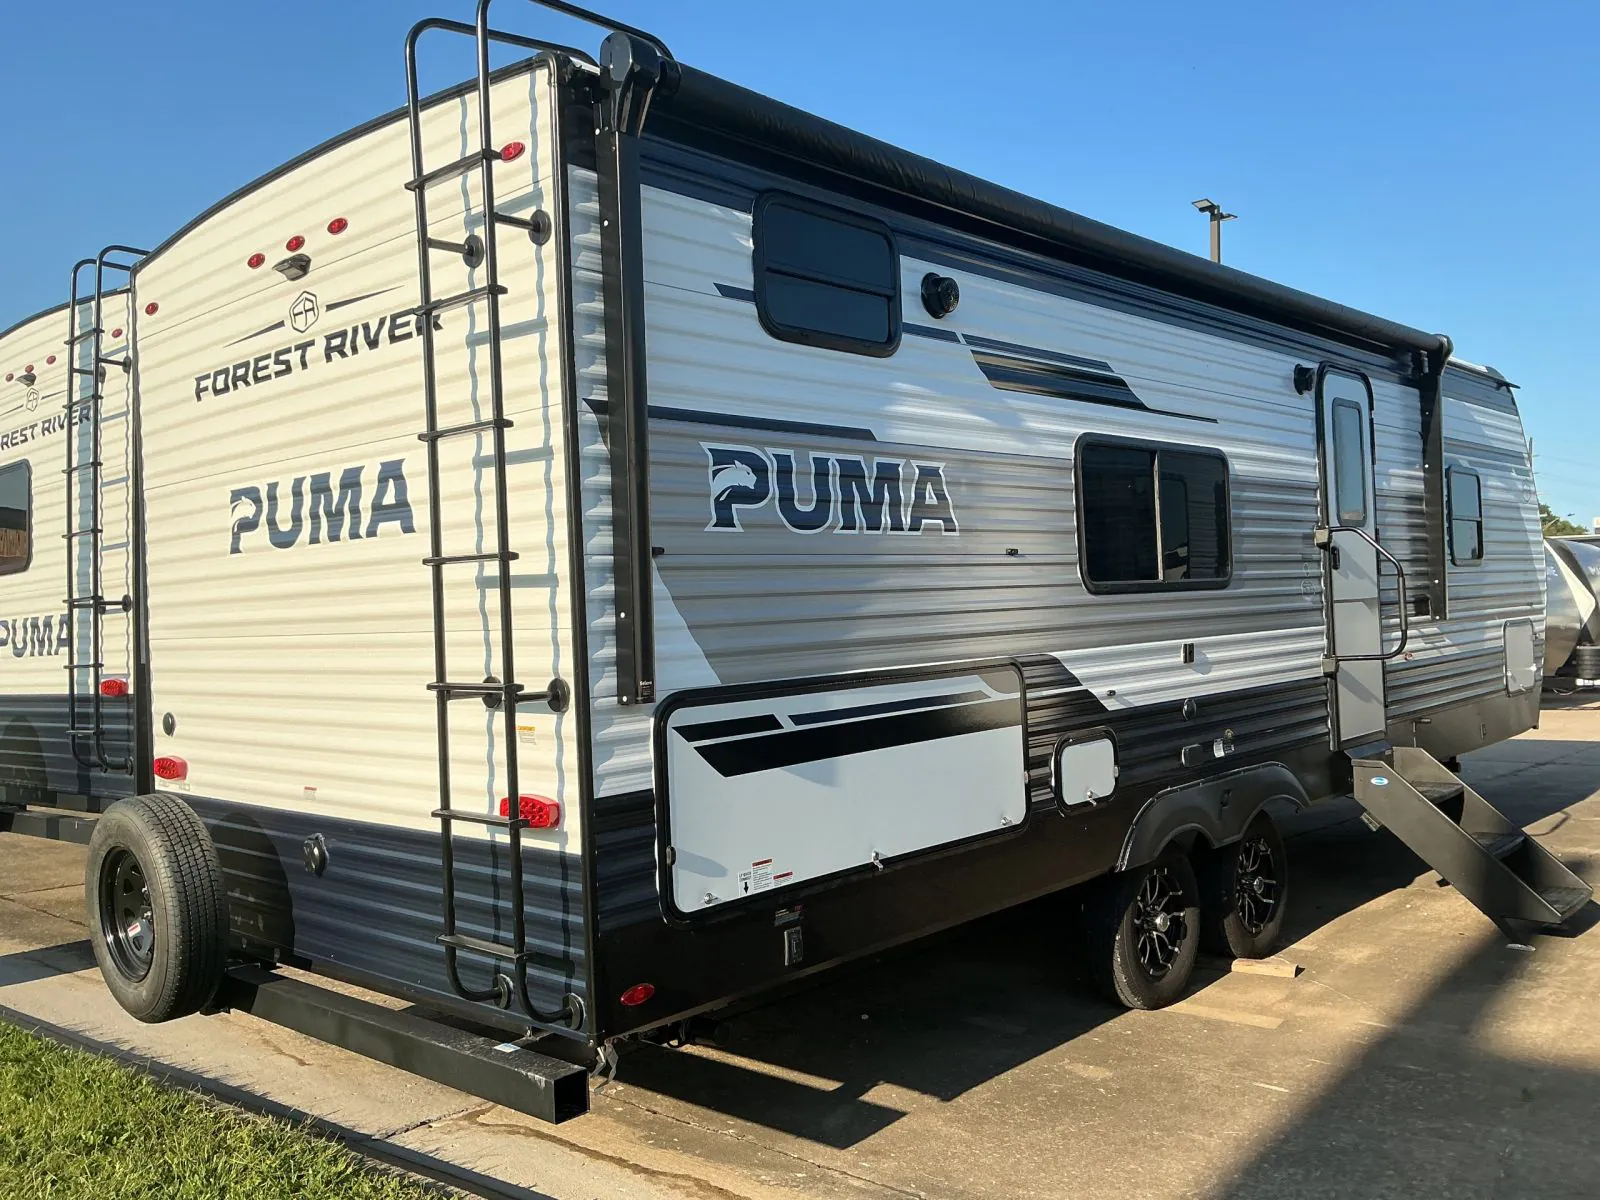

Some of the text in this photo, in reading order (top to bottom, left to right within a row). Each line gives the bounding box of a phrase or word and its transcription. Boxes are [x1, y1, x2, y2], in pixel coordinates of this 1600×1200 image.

[195, 339, 315, 402] FOREST
[230, 458, 416, 554] PUMA
[699, 442, 959, 536] PUMA
